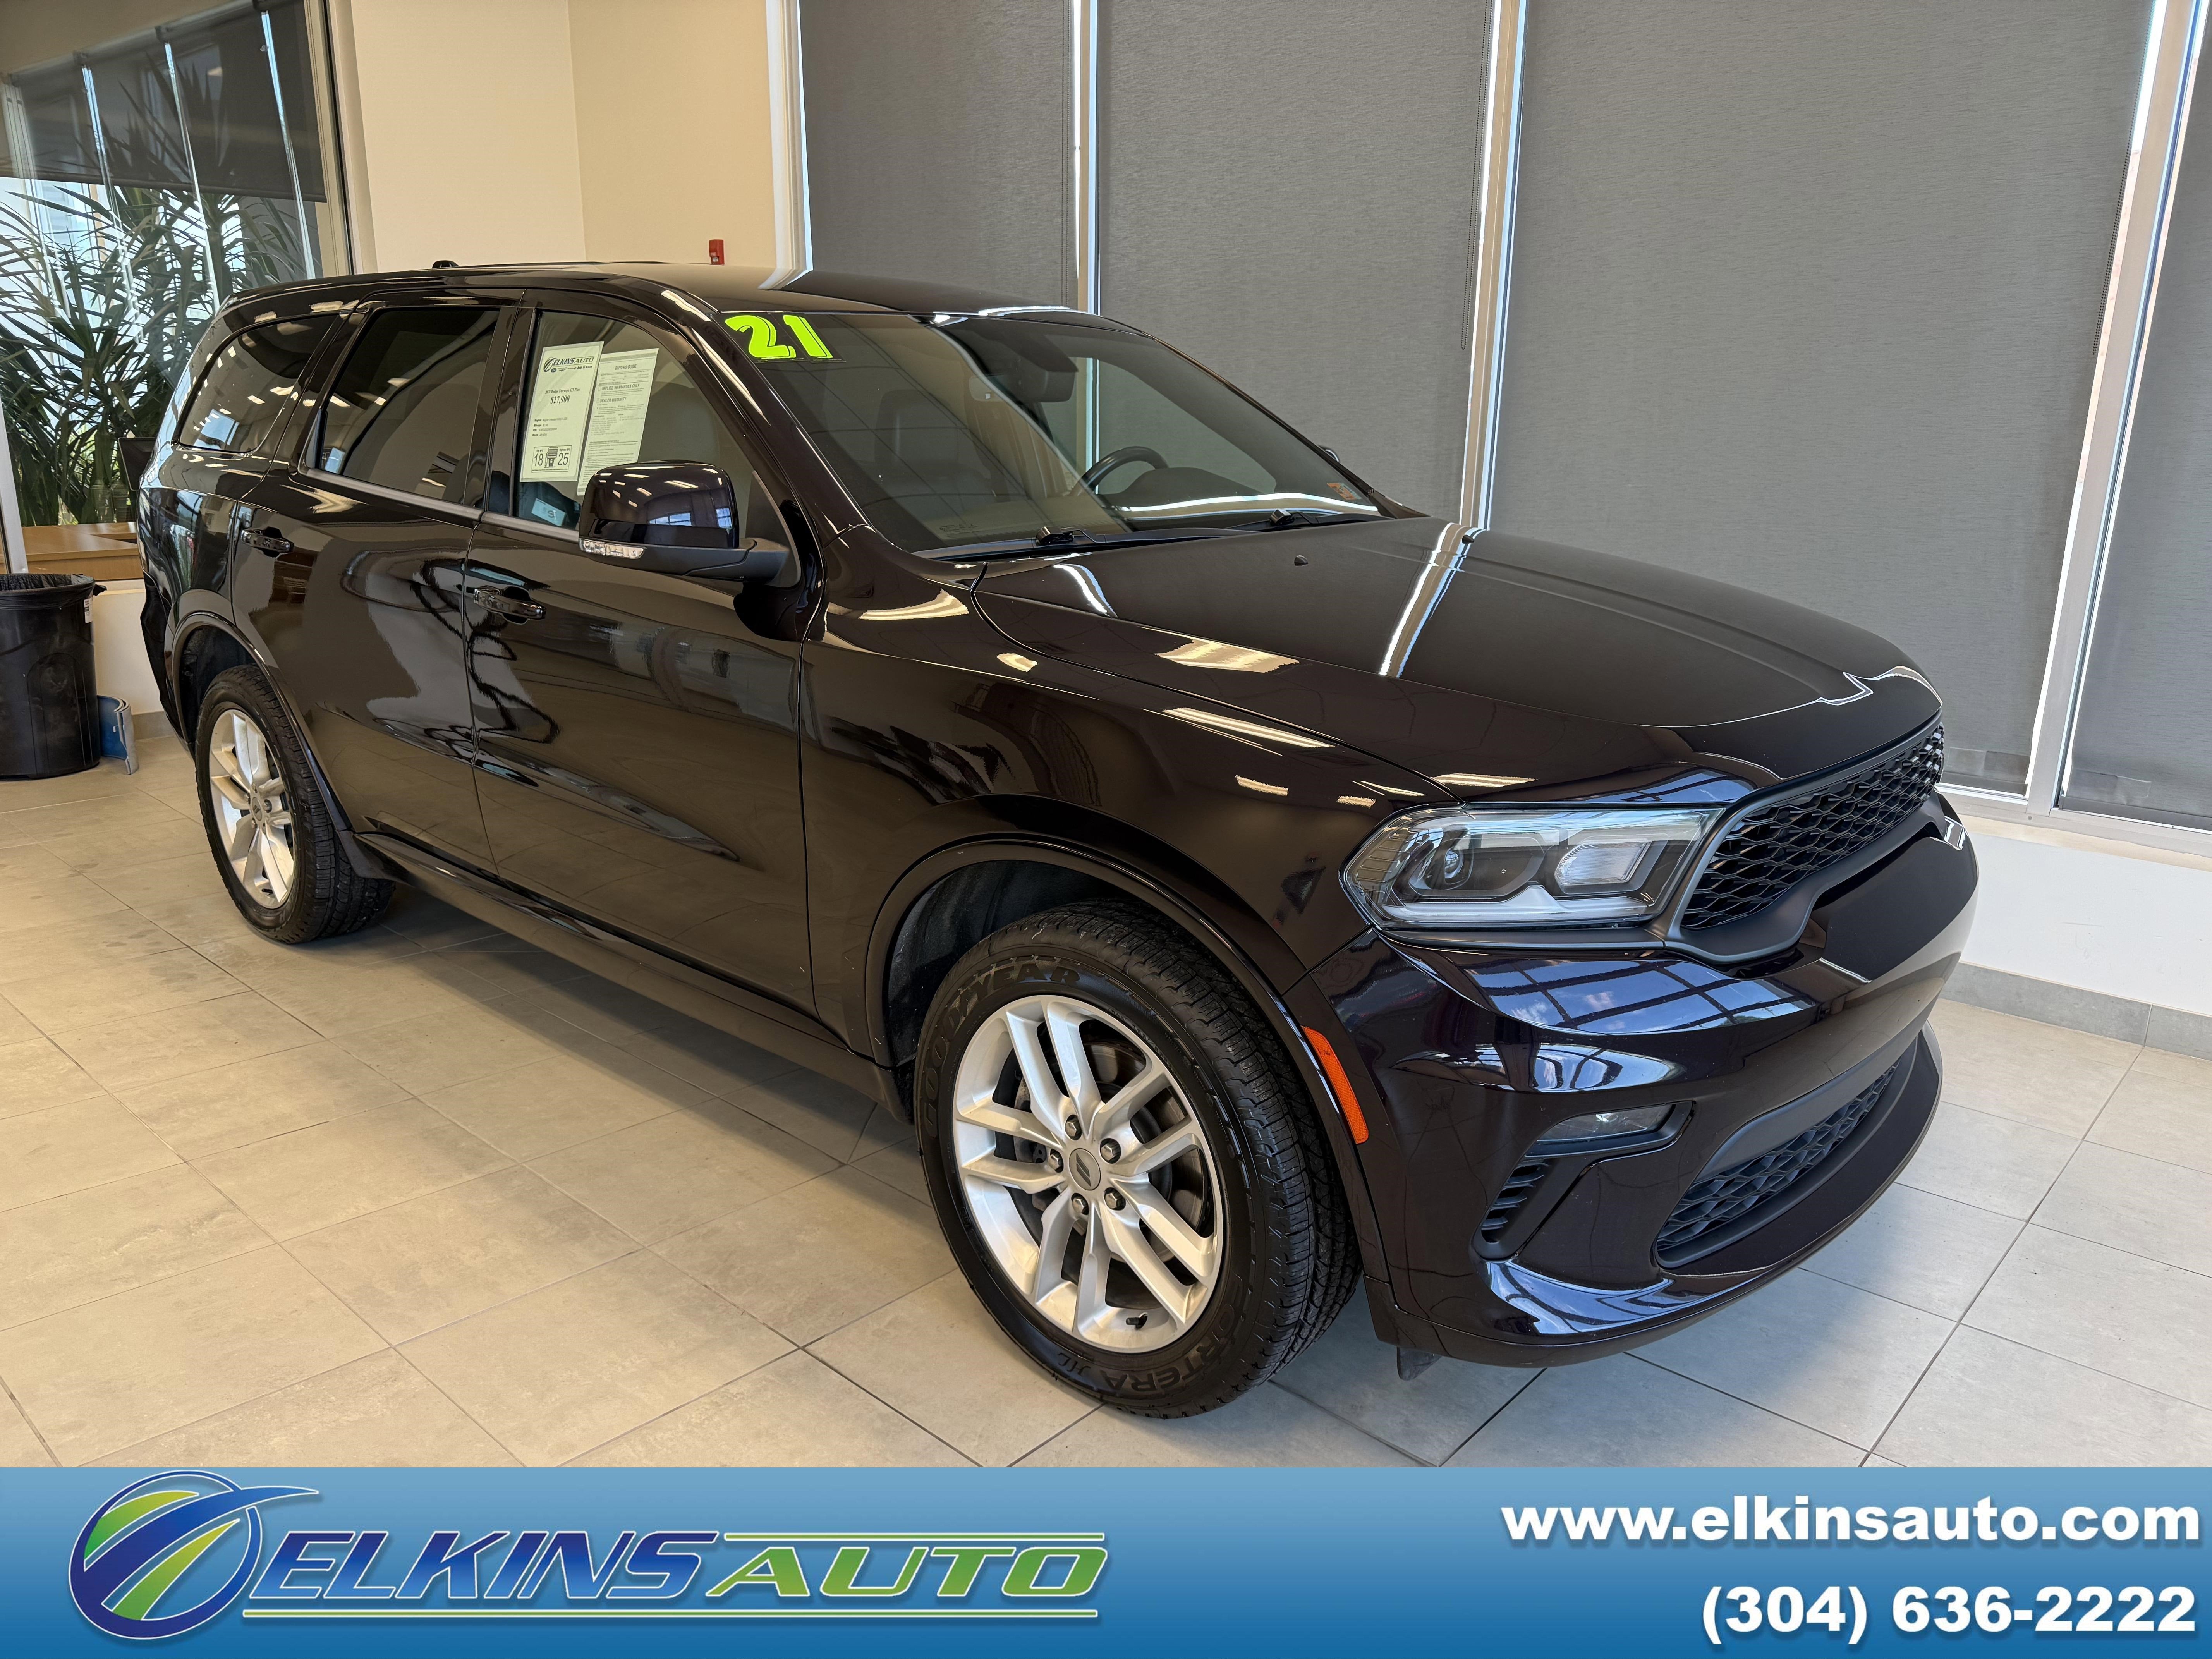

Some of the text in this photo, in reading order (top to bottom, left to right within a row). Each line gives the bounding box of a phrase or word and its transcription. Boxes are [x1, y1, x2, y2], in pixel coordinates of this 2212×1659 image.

[725, 315, 833, 359] 21
[553, 357, 576, 366] ELKINS
[550, 395, 570, 404] $27,900
[534, 453, 543, 466] 18
[558, 453, 569, 465] 25
[923, 963, 1081, 1139] GOODYEAR
